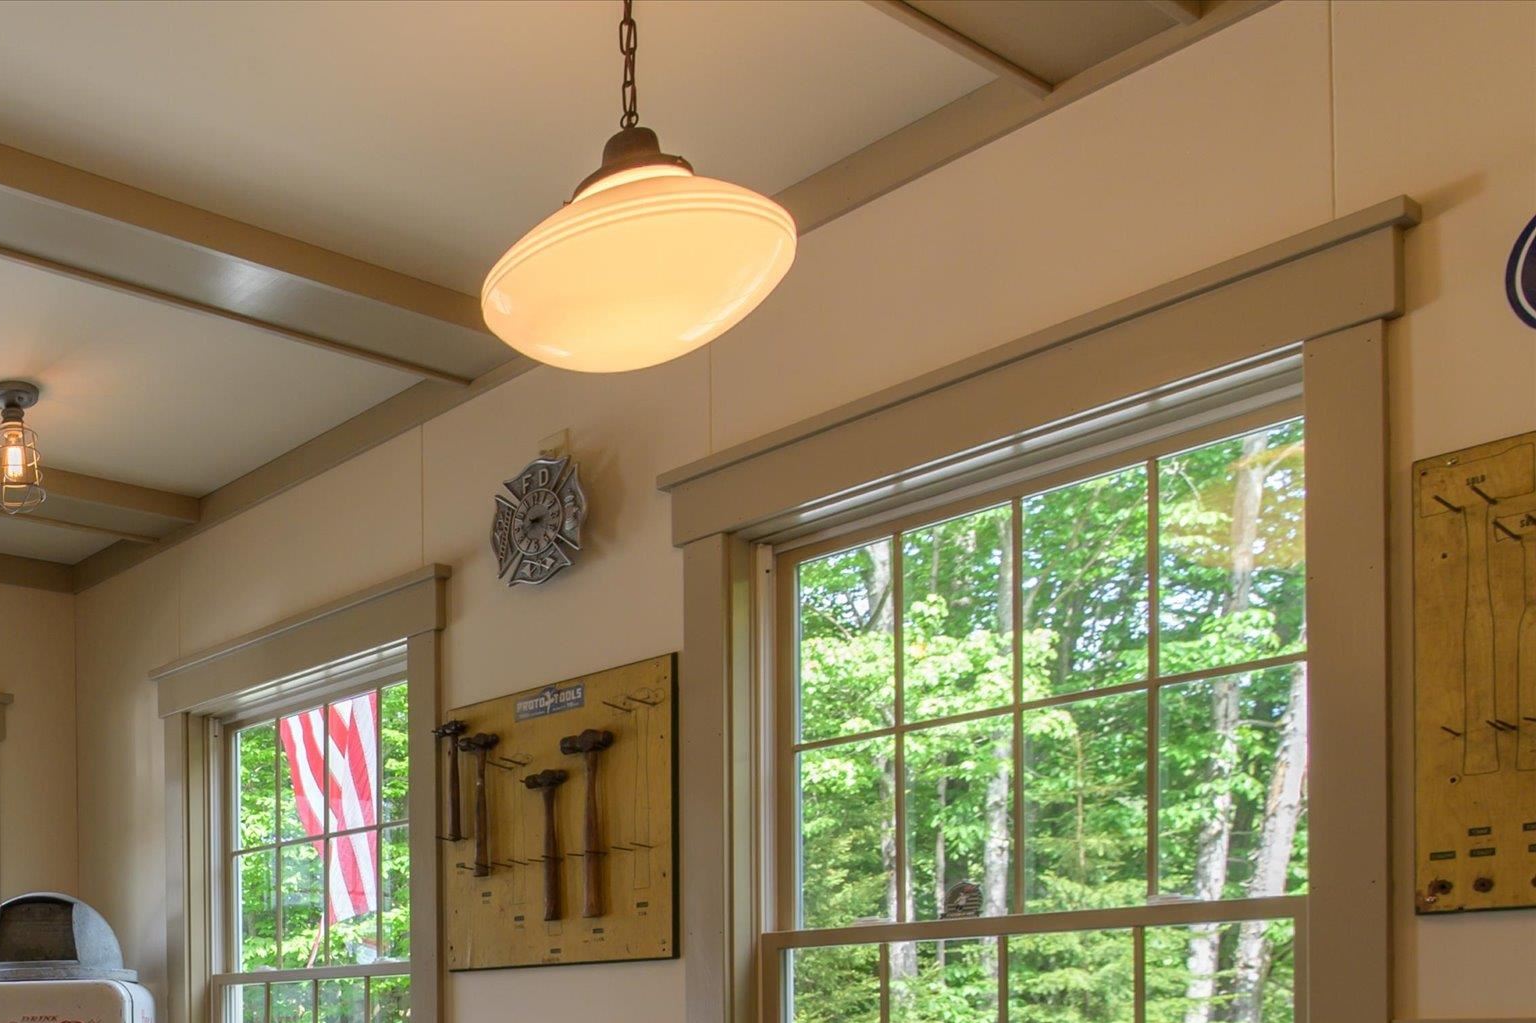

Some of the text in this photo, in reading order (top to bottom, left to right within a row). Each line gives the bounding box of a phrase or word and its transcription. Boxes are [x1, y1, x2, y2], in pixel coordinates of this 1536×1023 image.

[517, 696, 546, 714] PROTO
[553, 687, 582, 704] TOOLS
[21, 1015, 58, 1023] DRINK
